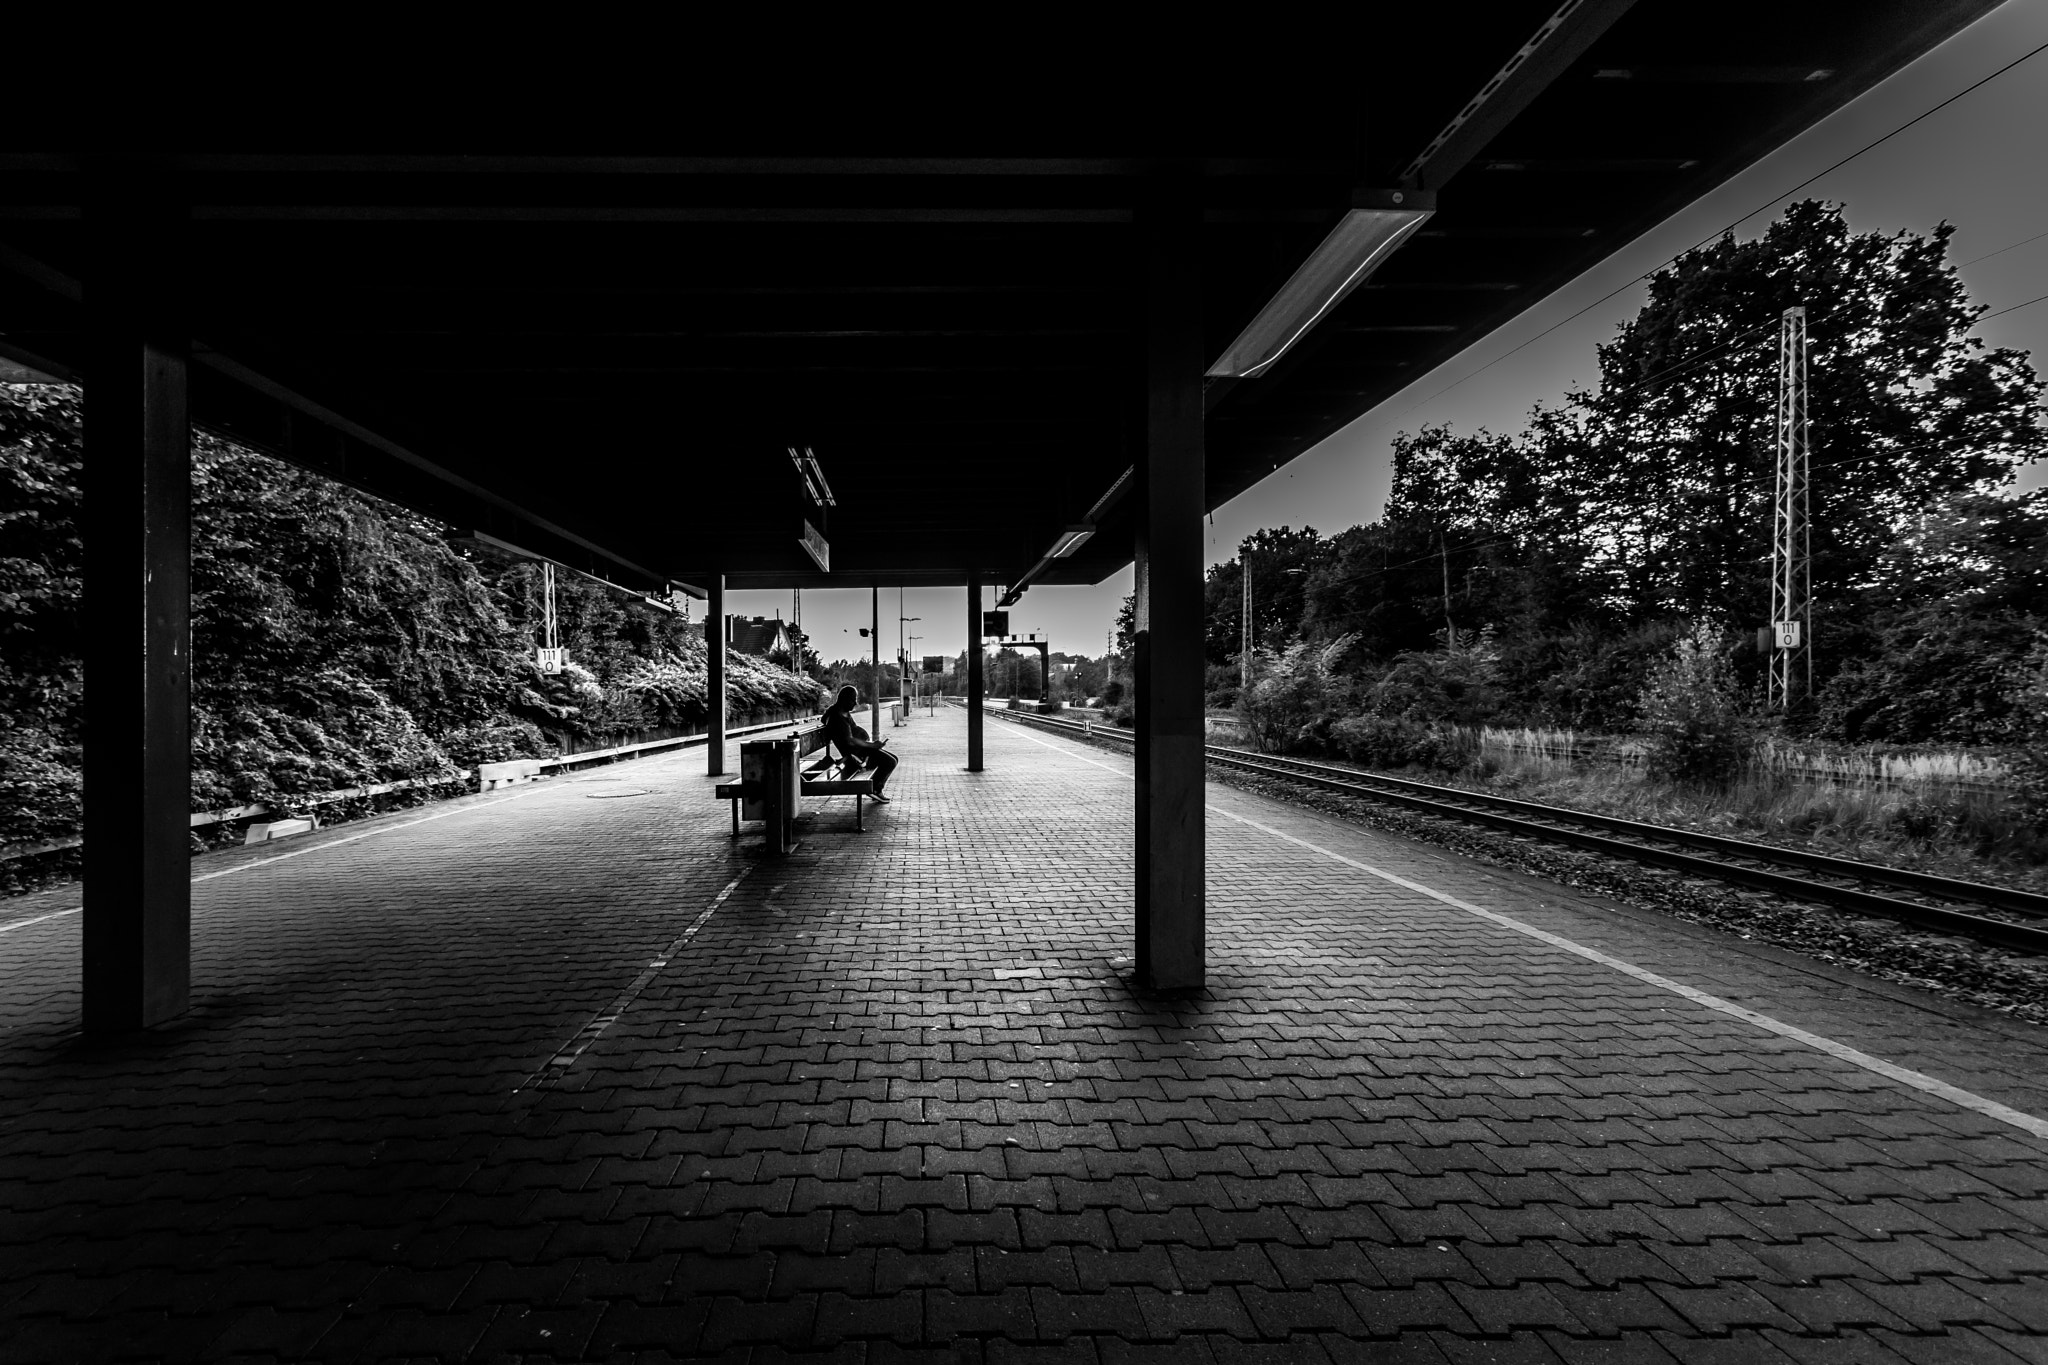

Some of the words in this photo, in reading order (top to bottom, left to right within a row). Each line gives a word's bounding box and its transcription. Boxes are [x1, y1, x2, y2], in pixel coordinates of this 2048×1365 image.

[1782, 623, 1795, 633] 111
[1784, 635, 1792, 645] 0
[543, 651, 555, 660] 111
[546, 662, 553, 671] 0
